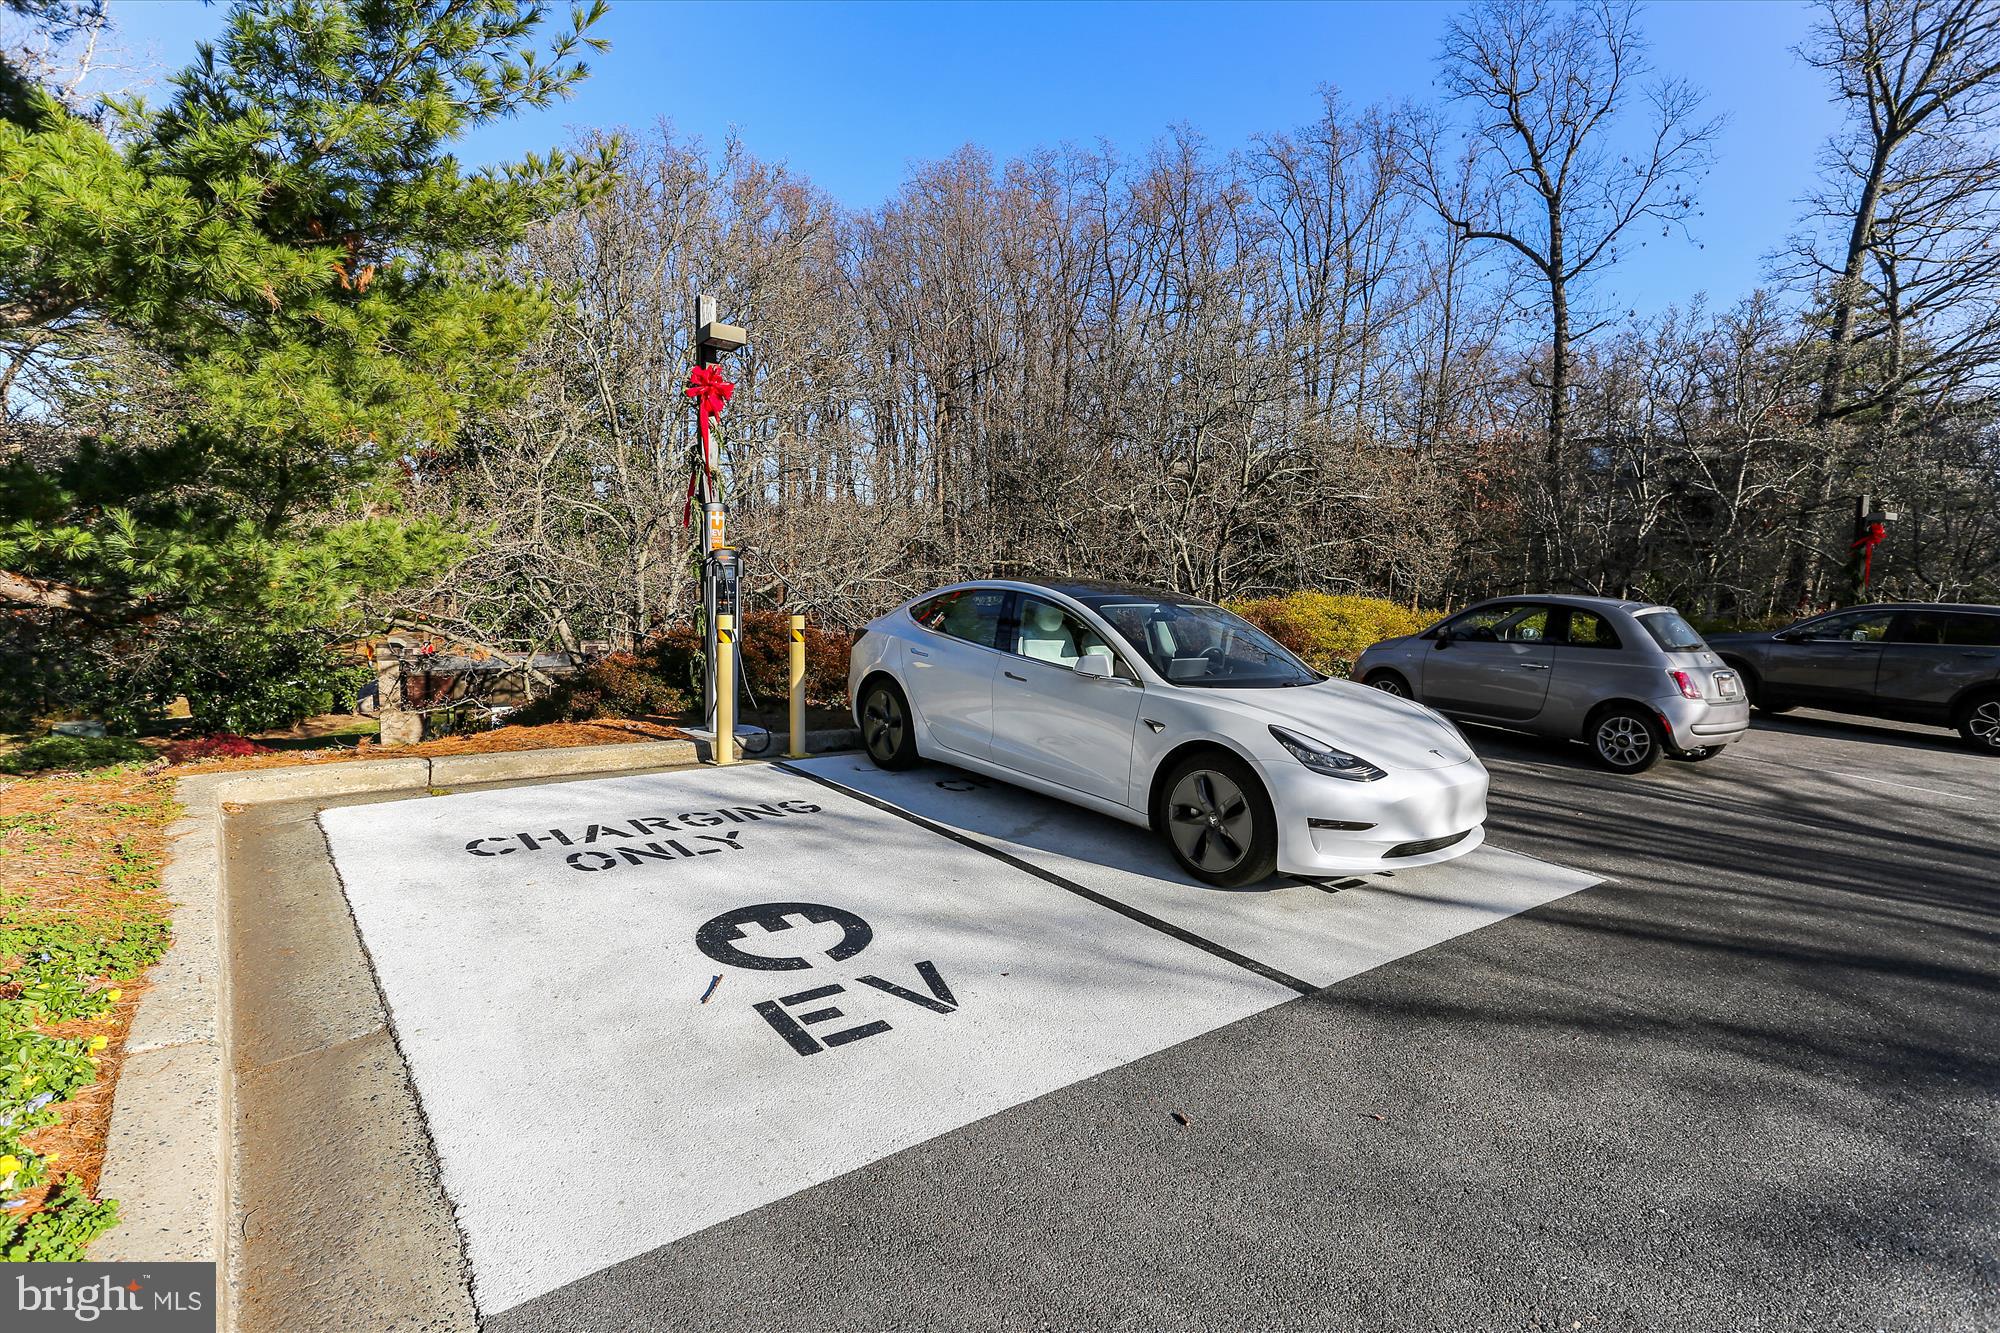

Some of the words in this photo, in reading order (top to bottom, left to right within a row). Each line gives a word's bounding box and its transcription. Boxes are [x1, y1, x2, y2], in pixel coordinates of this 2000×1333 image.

[712, 529, 723, 537] EV
[465, 799, 822, 857] CHARGING
[566, 831, 744, 872] ONLY
[753, 960, 959, 1057] EV
